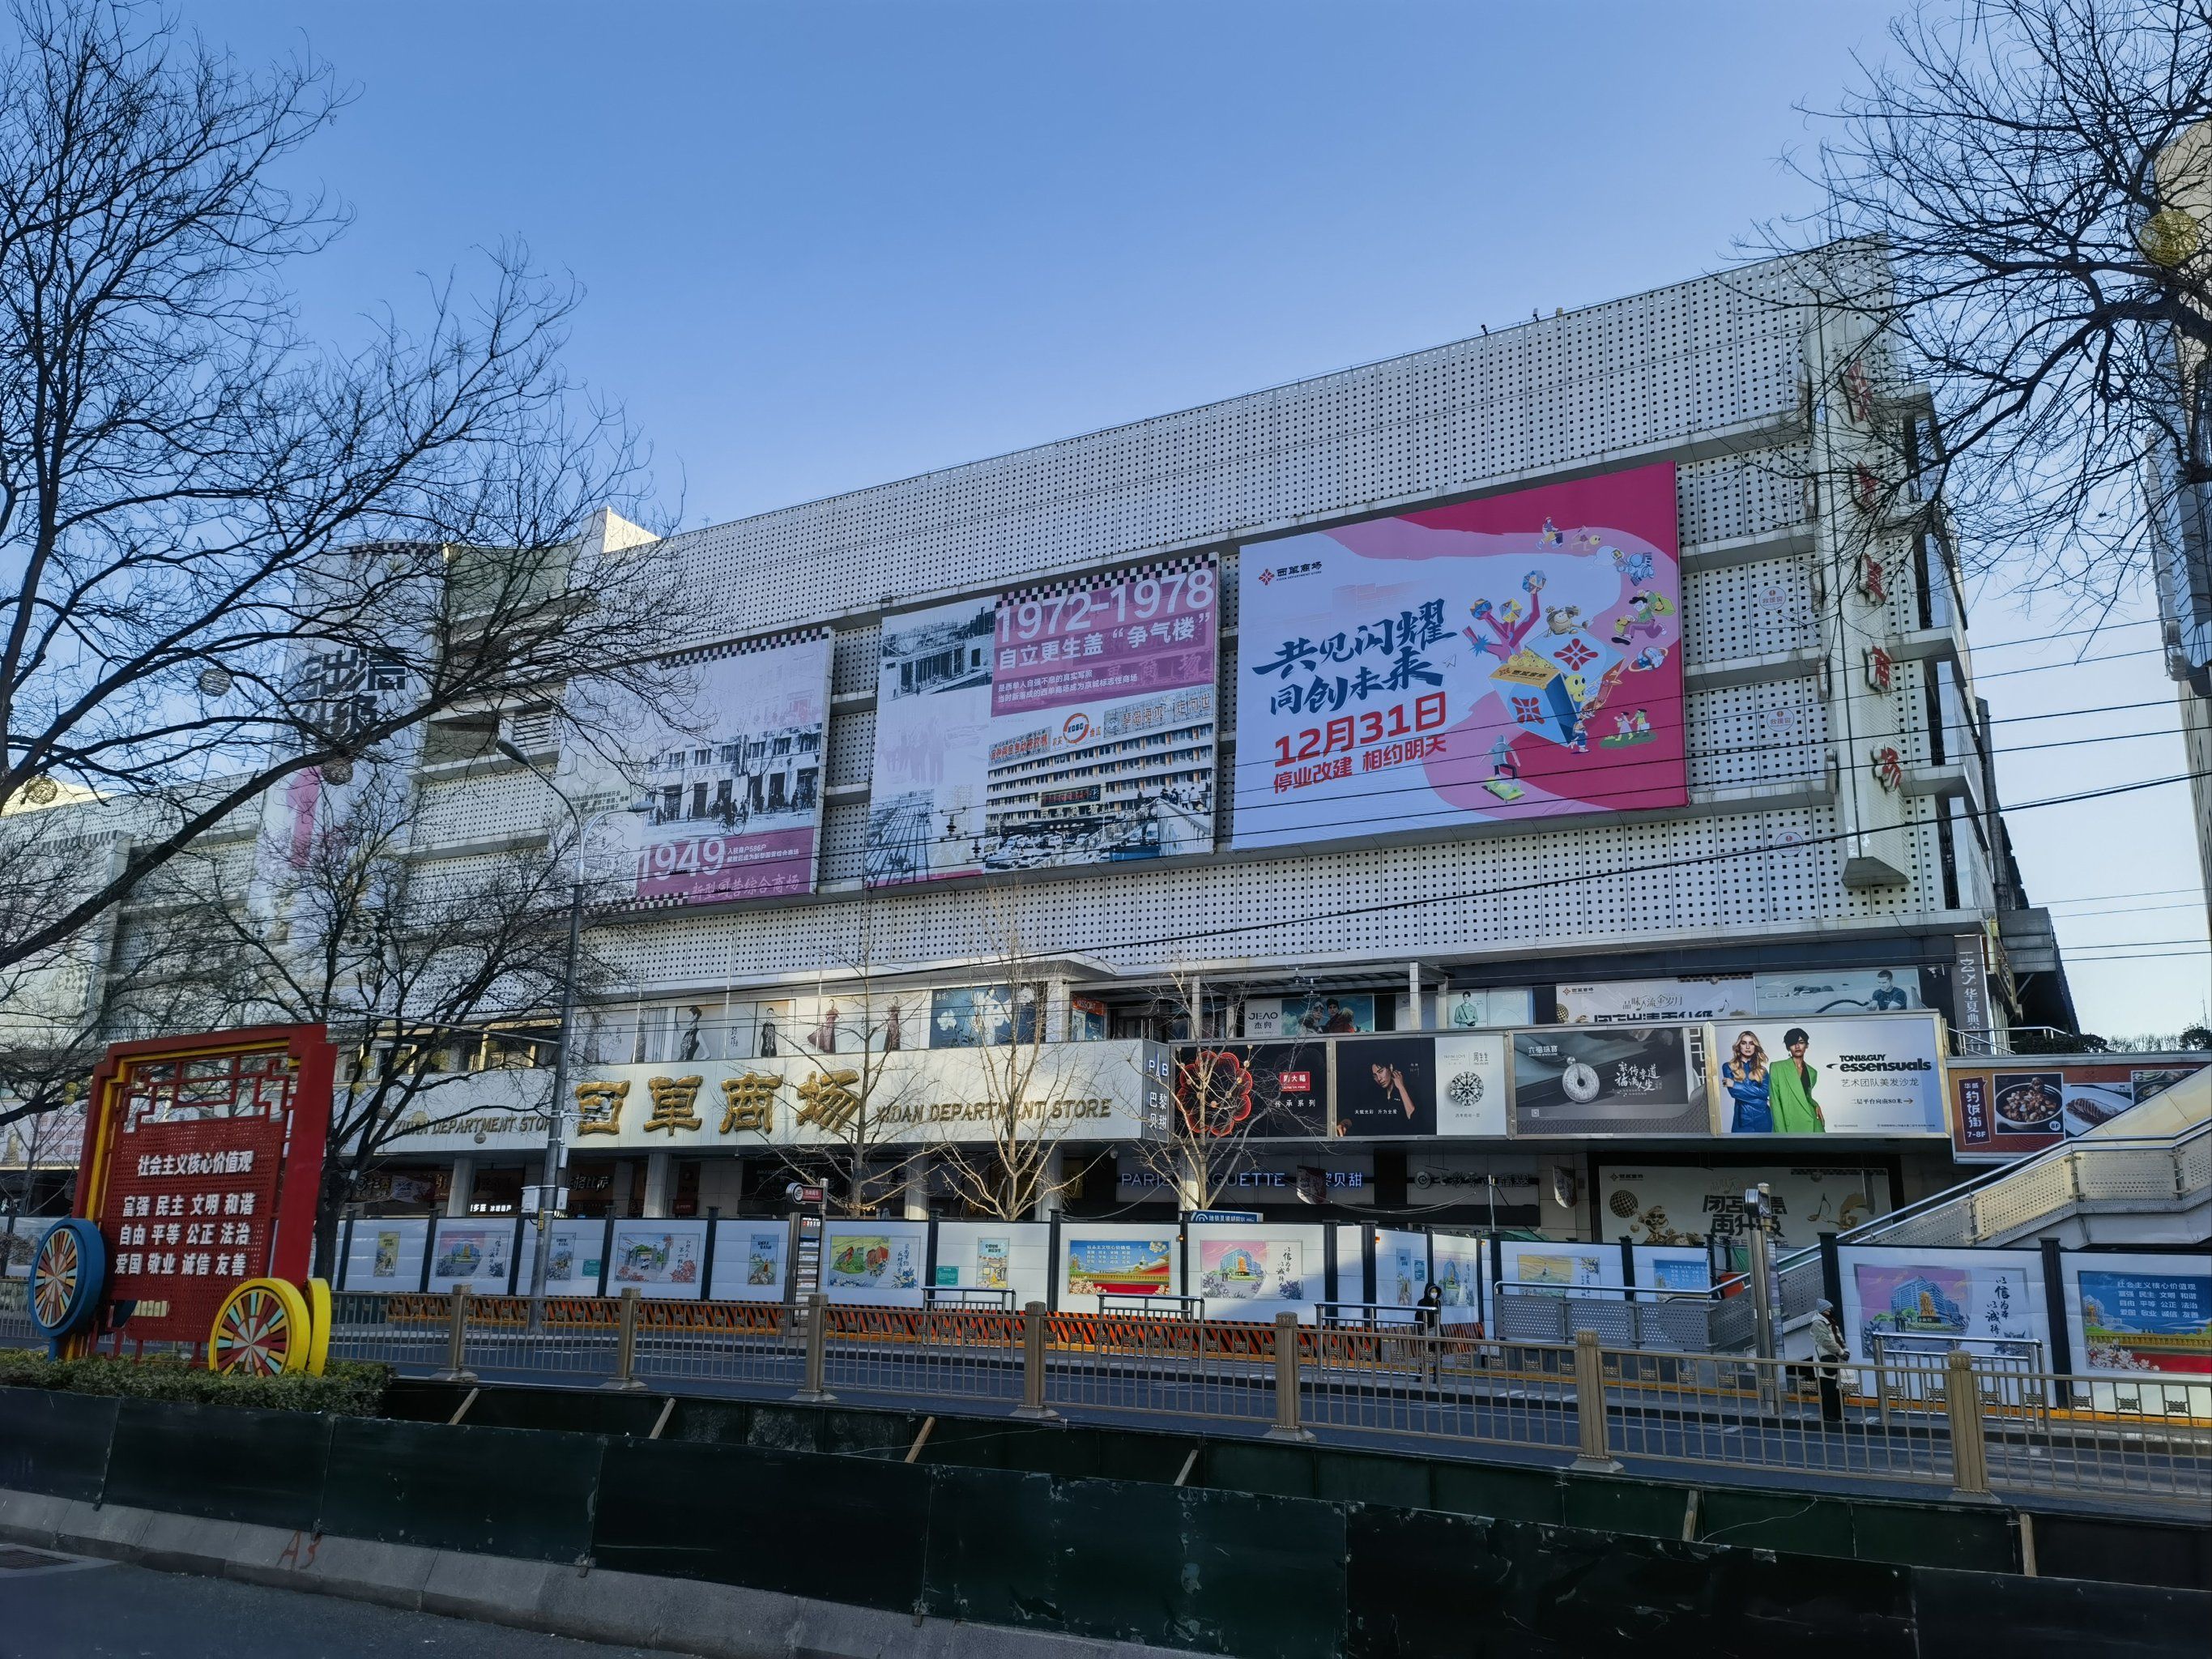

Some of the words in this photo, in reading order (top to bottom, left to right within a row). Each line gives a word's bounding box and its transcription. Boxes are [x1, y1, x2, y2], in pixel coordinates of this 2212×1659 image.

[996, 569, 1213, 643] 1972-1978
[1252, 598, 1457, 680] 共见闪耀
[1271, 646, 1443, 714] 同创未来
[1275, 691, 1446, 767] 12月31日
[1273, 756, 1353, 794] 停业改建
[1362, 734, 1447, 772] 相约明天
[640, 836, 726, 882] 1949
[1764, 990, 1811, 1000] ERKE
[1839, 1058, 1932, 1072] essensuals
[1841, 1078, 1920, 1087] 艺术团队美发沙龙
[931, 1100, 1046, 1122] DEPARTMNT
[1052, 1098, 1112, 1119] STORE
[1966, 1090, 1982, 1128] 约饭街
[138, 1150, 254, 1176] 社会主义核心价值观
[122, 1196, 150, 1217] 富强
[156, 1195, 185, 1216] 民主
[190, 1193, 219, 1215] 文明
[224, 1192, 255, 1215] 和谐
[119, 1224, 147, 1245] 自由
[151, 1224, 181, 1245] 平等
[186, 1223, 215, 1245] 公正
[219, 1222, 250, 1245] 法治
[115, 1253, 143, 1274] 爱国
[147, 1252, 176, 1274] 敬业
[181, 1253, 211, 1275] 诚信
[215, 1253, 246, 1276] 友善
[2117, 1281, 2196, 1290] 社会主义核心价值观
[1985, 1301, 2001, 1335] 以诚待
